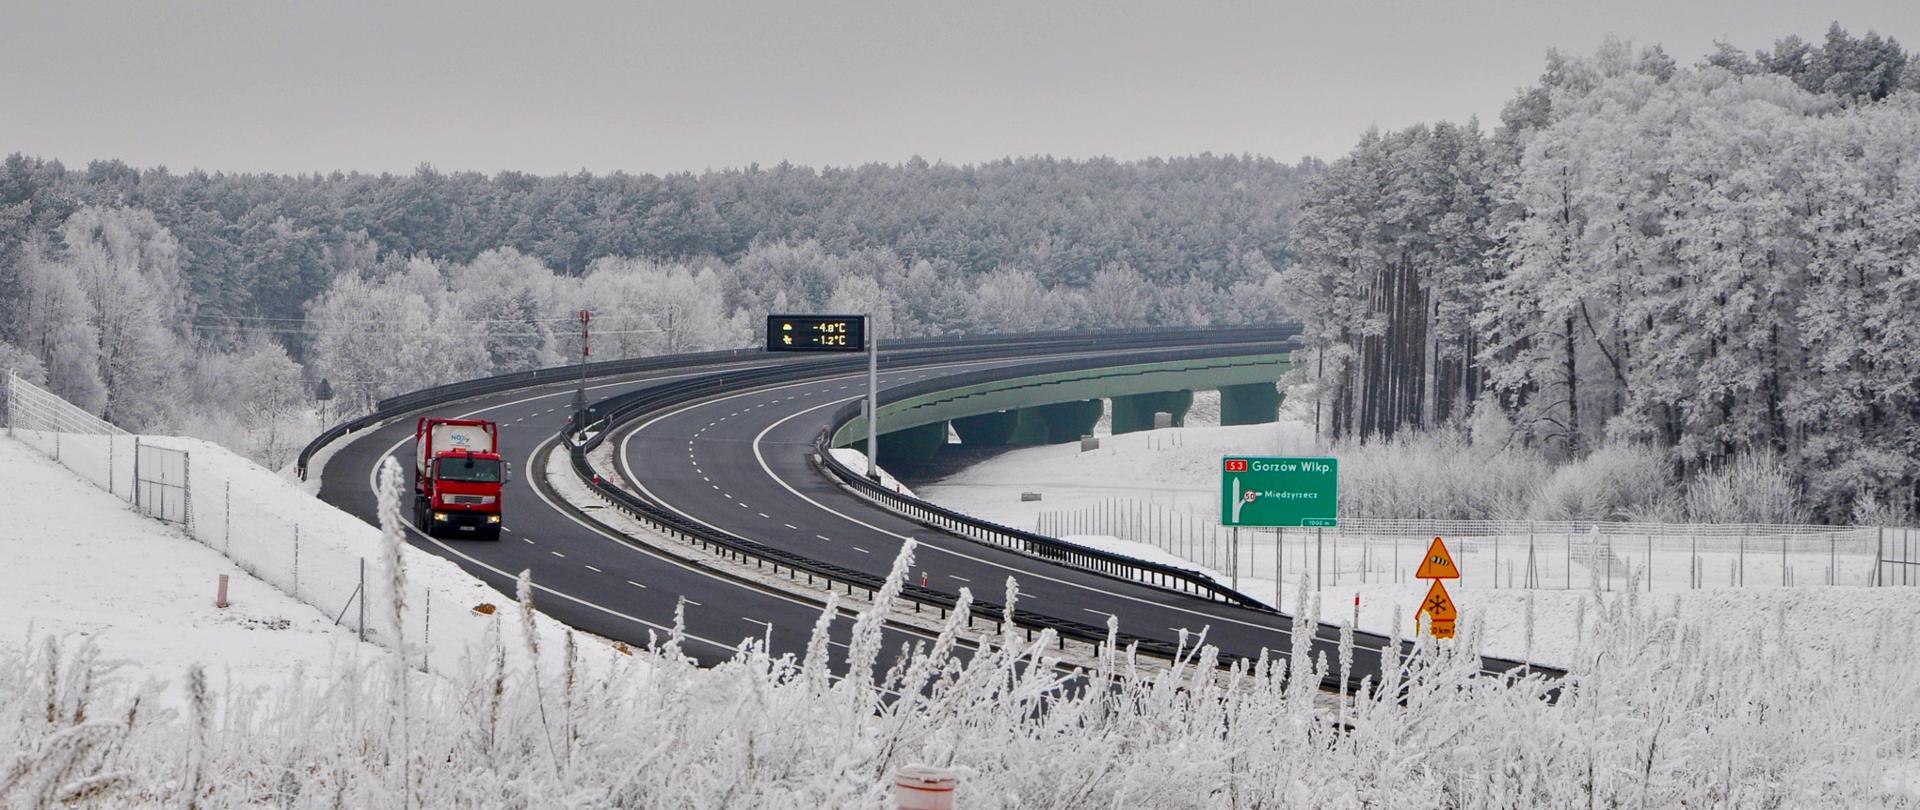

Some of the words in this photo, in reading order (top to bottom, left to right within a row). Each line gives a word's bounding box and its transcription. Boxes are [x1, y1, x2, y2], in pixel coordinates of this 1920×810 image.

[813, 322, 846, 333] -4.8°C
[1252, 460, 1297, 472] Gorzów
[1301, 461, 1333, 474] Wlkp.
[1264, 491, 1318, 501] Międzyrzecz
[1439, 626, 1450, 634] km
